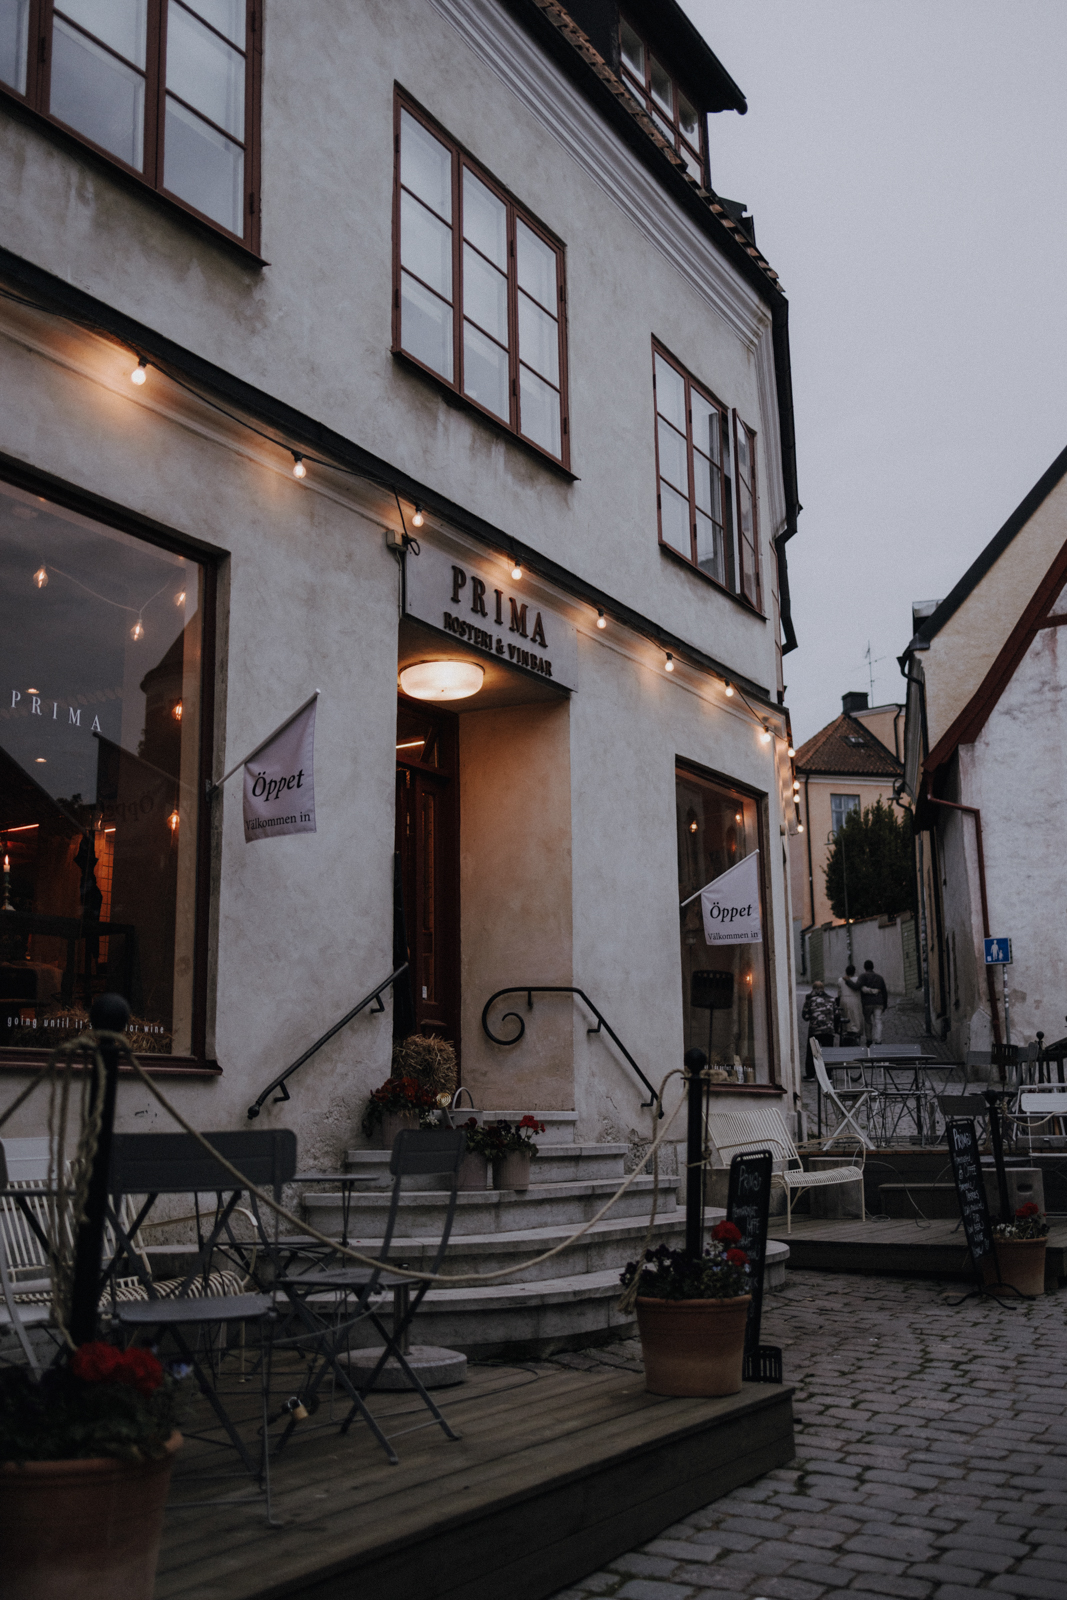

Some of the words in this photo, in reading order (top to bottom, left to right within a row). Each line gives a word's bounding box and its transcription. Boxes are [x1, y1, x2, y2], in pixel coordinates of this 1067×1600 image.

[451, 565, 548, 648] PRIMA
[443, 611, 493, 651] ROSTERI
[495, 638, 505, 655] &
[507, 643, 553, 677] VINBAR
[11, 690, 102, 733] PRIMA
[252, 769, 304, 802] Öppet
[245, 814, 297, 831] Välkommen
[300, 812, 311, 823] in
[710, 902, 752, 922] Öppet
[708, 932, 749, 940] Välkommen
[750, 930, 758, 938] in
[7, 1015, 37, 1029] going
[43, 1017, 70, 1029] until
[144, 1023, 165, 1034] wine
